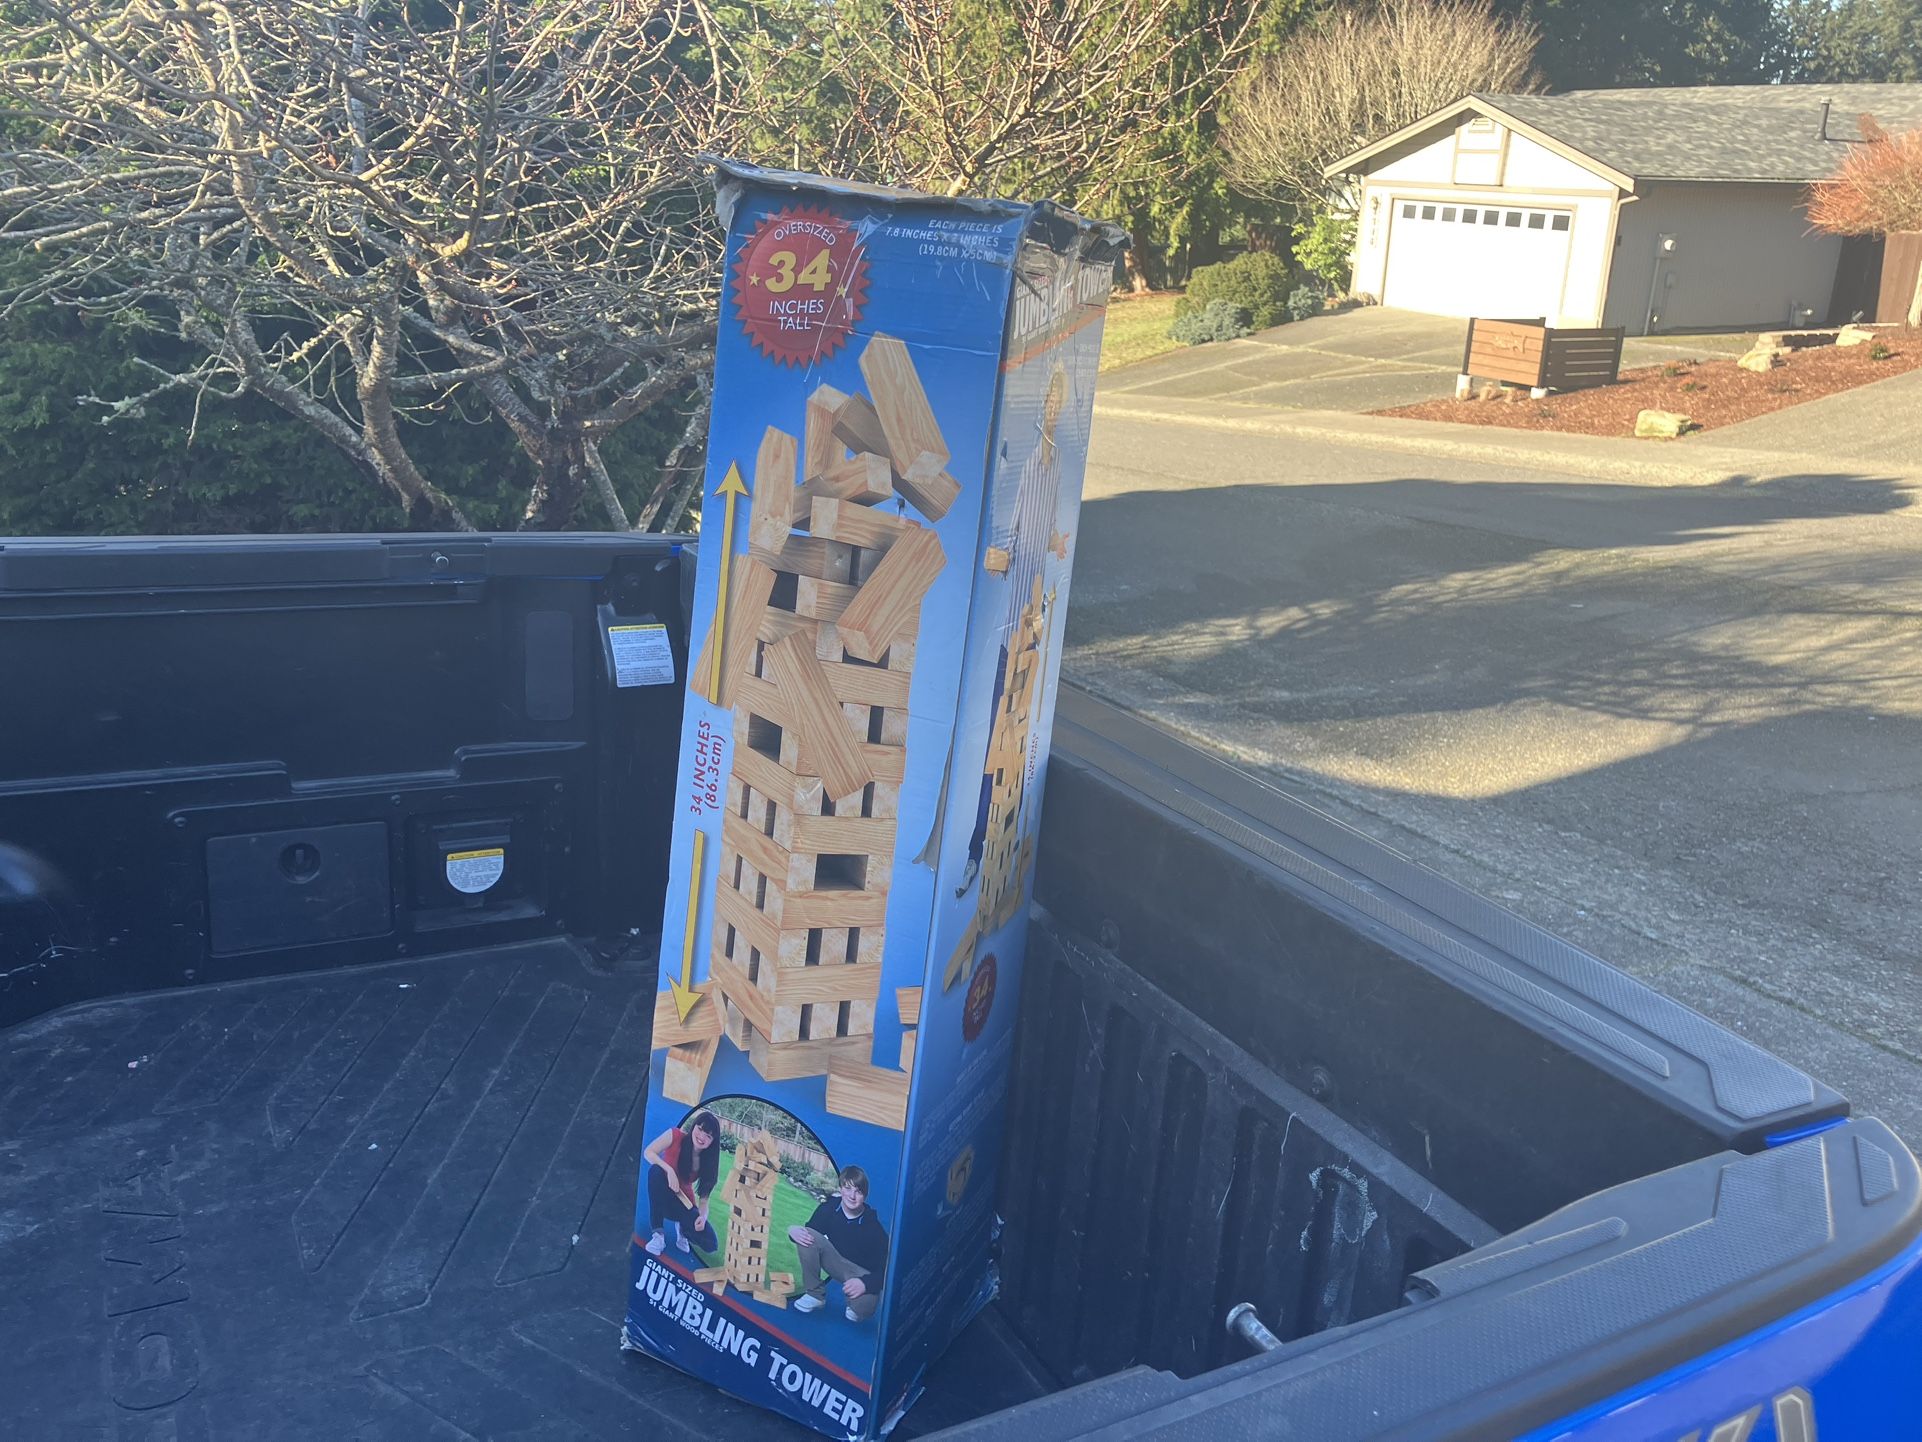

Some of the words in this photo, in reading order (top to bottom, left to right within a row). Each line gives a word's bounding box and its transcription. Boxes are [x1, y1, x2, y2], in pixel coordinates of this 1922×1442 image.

[774, 222, 837, 247] OVERSIZED
[885, 227, 899, 237] 7.8
[901, 229, 939, 241] INCHES
[960, 234, 999, 247] INCHES
[928, 220, 955, 230] EACH
[958, 222, 989, 233] PIECE
[992, 224, 1003, 233] IS
[919, 244, 958, 257] (19.8CM
[764, 248, 832, 293] 34
[768, 299, 825, 316] INCHES
[778, 315, 812, 330] TALL
[693, 720, 711, 789] INCHES
[704, 735, 726, 810] (86.3cm)
[690, 794, 703, 816] 34
[646, 1258, 676, 1285] GIANT
[675, 1279, 705, 1302] SIZED
[649, 1298, 657, 1306] 51
[658, 1305, 679, 1321] GIANT
[679, 1318, 700, 1337] WOOD
[700, 1332, 724, 1353] PIECES
[635, 1264, 761, 1368] JUMBLING
[767, 1350, 865, 1432] TOWER
